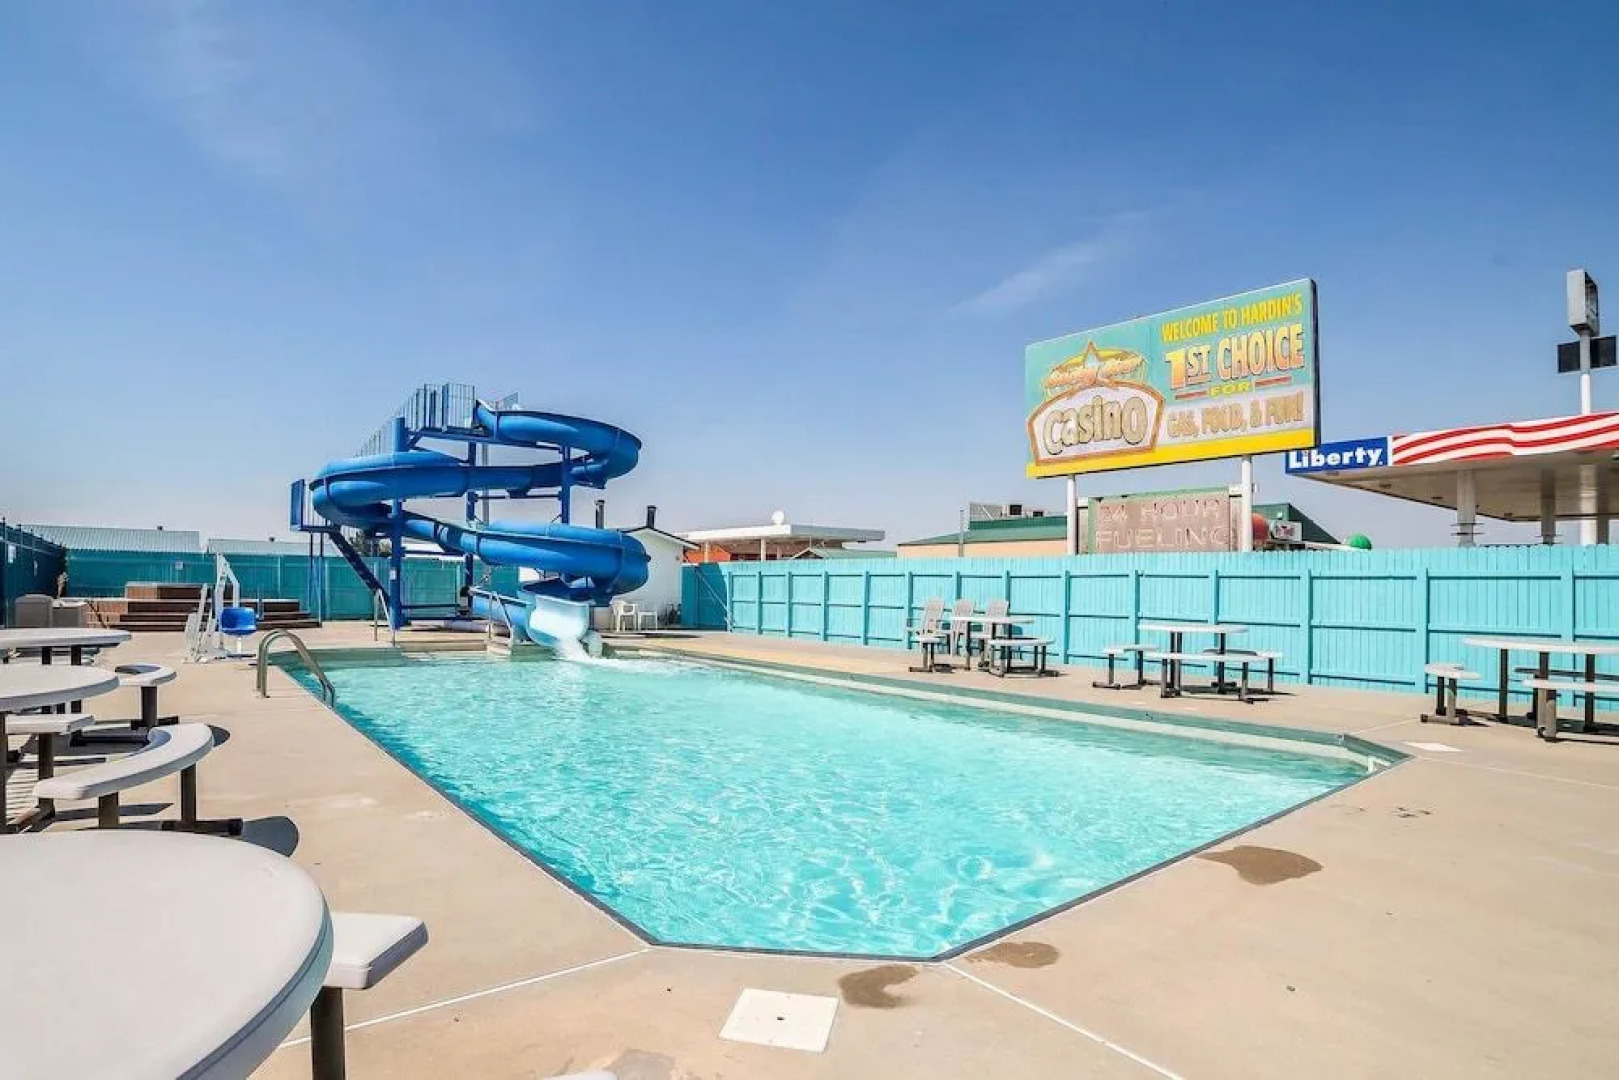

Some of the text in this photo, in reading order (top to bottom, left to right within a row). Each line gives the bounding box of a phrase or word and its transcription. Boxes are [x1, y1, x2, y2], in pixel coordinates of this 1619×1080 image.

[1162, 293, 1303, 342] WELCOME TO HARDIN'S
[1165, 344, 1211, 390] 1ST
[1218, 323, 1305, 381] CHOICE
[1210, 381, 1249, 397] FOR
[1289, 447, 1382, 468] Liberty
[1099, 500, 1219, 522] 24 HOUR
[1095, 526, 1227, 548] FUELING
